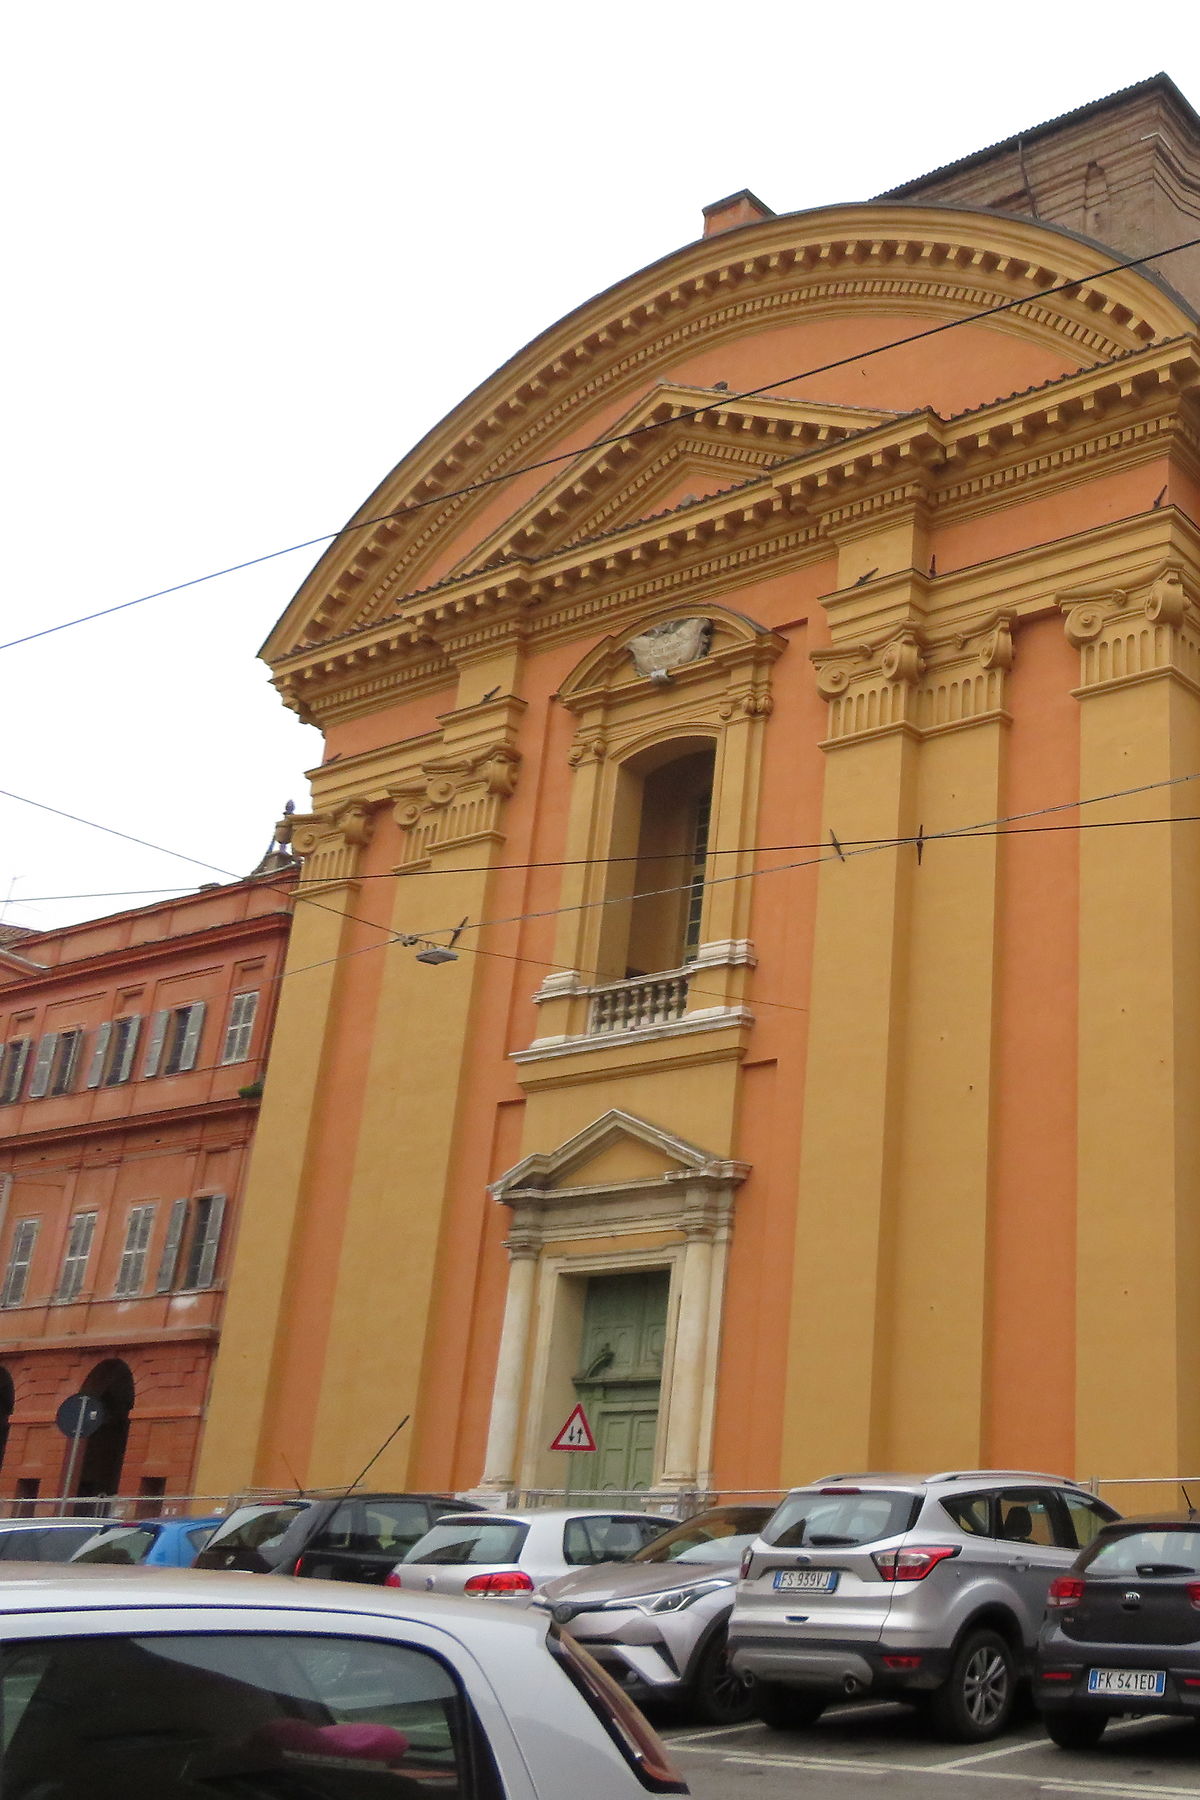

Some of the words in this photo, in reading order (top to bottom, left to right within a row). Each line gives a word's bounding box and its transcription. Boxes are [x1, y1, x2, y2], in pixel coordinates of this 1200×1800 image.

[781, 1572, 795, 1586] FS
[797, 1572, 831, 1587] 939VJ
[1098, 1672, 1112, 1688] FK
[1117, 1673, 1155, 1690] 541ED
